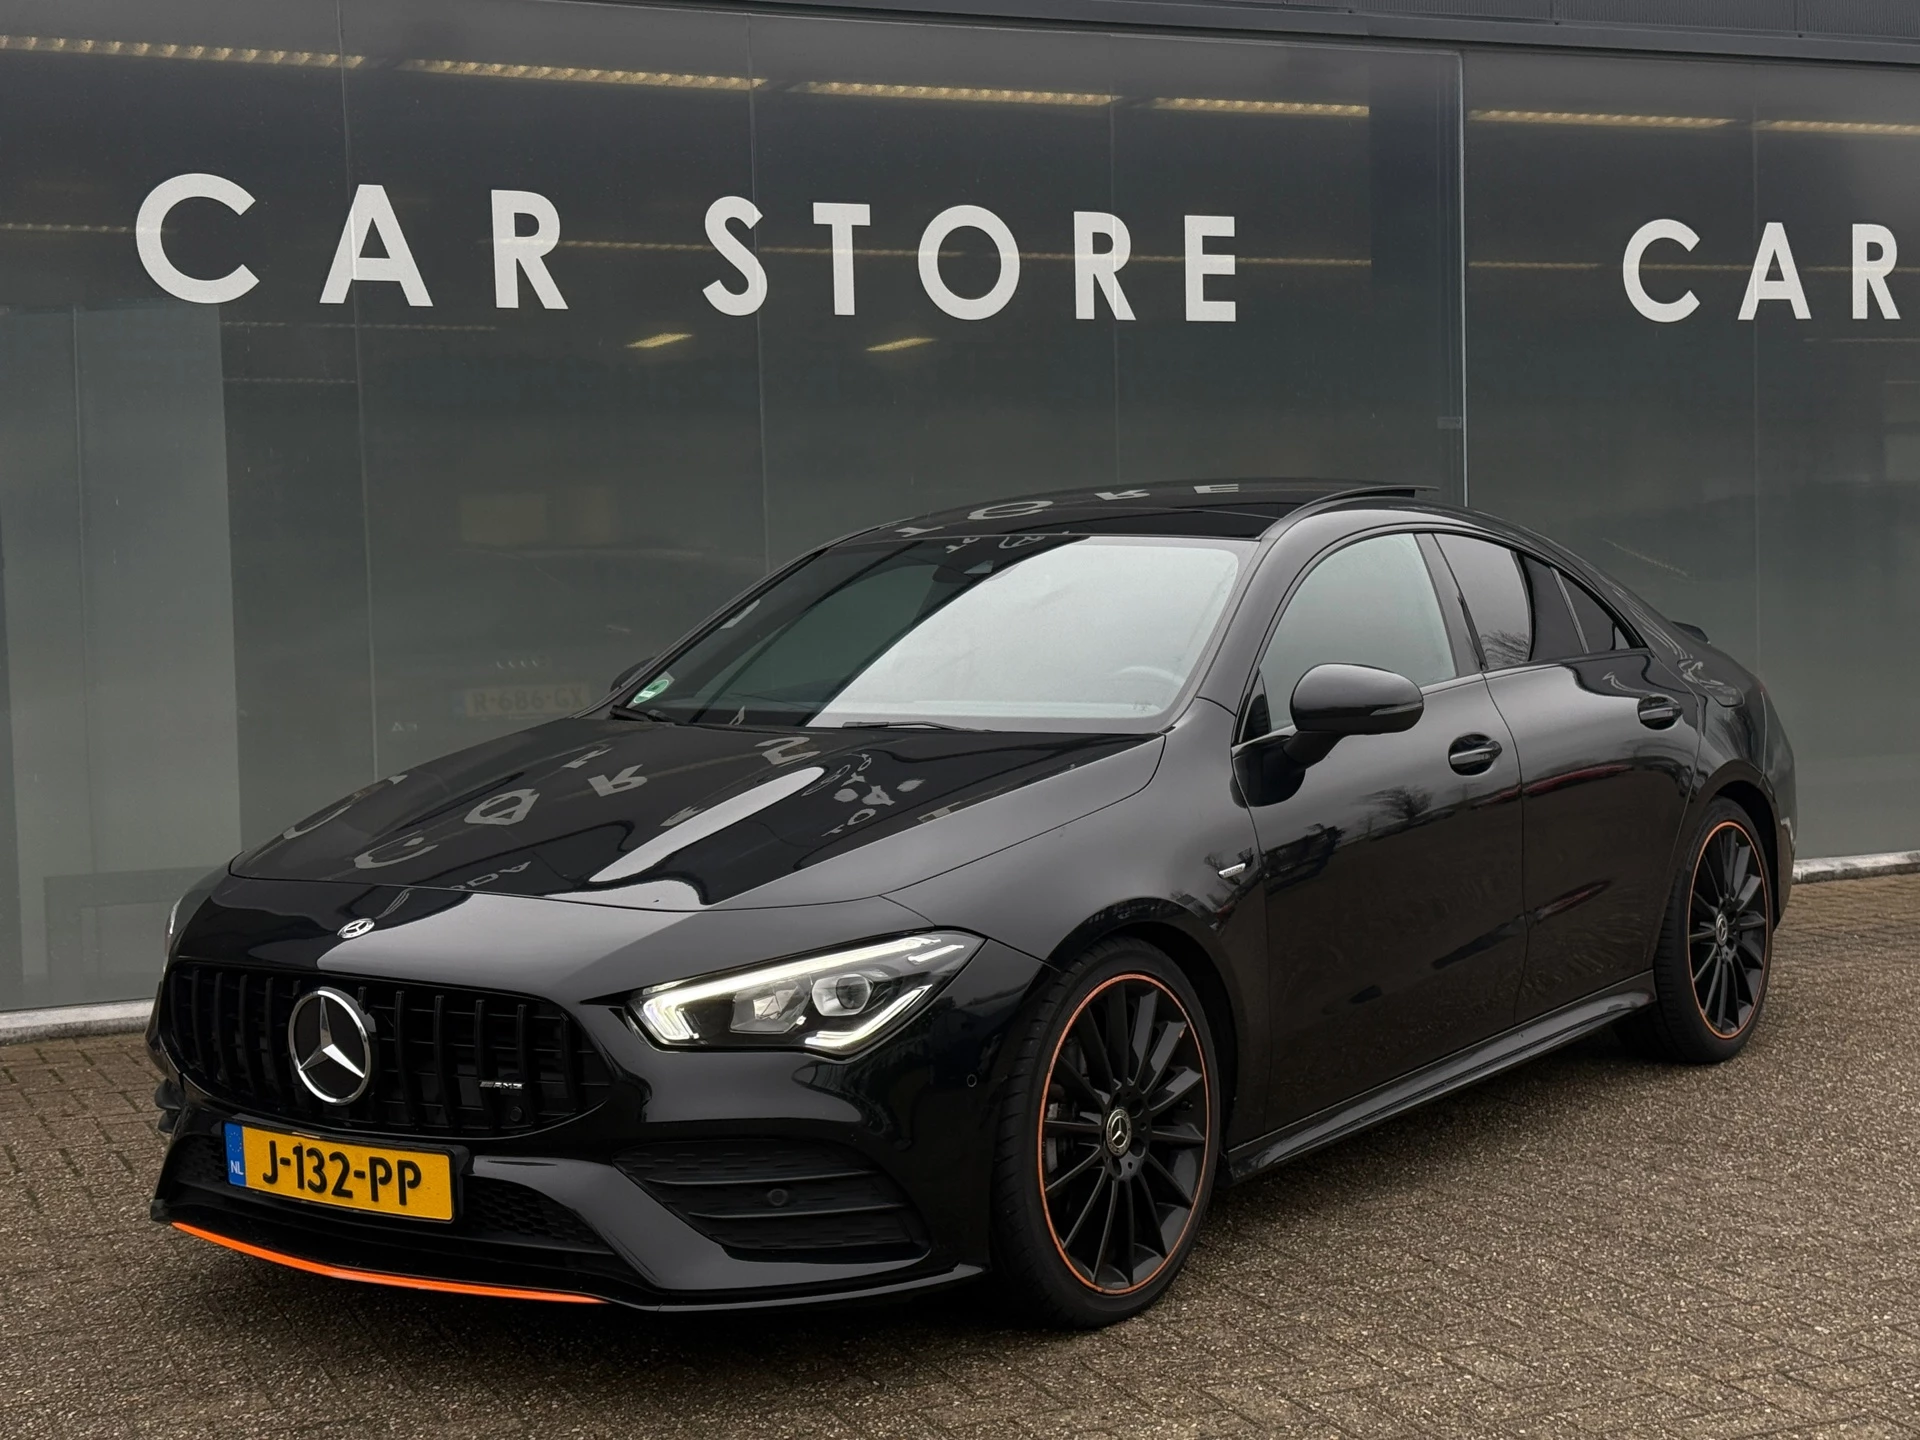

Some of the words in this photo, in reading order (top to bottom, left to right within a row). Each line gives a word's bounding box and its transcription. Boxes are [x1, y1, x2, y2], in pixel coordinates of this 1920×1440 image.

[135, 173, 568, 310] CAR
[702, 195, 1237, 322] STORE
[1622, 218, 1901, 323] CAR
[229, 1159, 244, 1176] NL
[262, 1139, 422, 1206] J-132-PP
